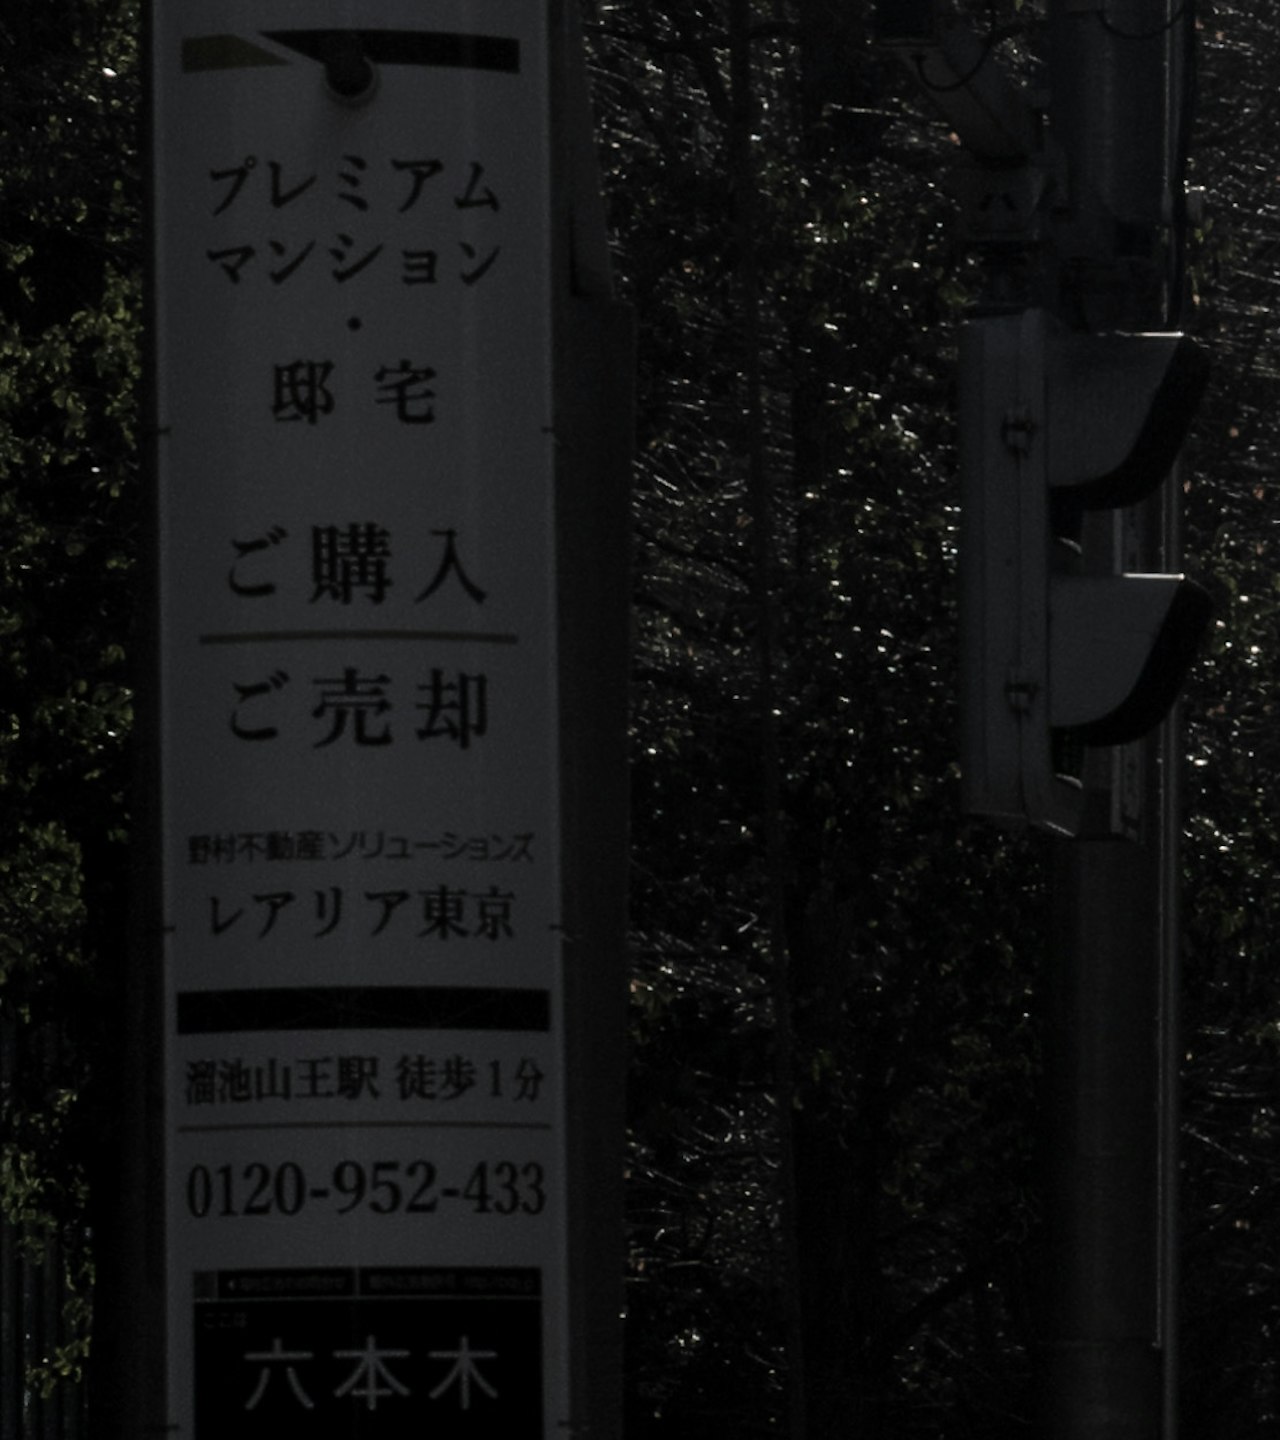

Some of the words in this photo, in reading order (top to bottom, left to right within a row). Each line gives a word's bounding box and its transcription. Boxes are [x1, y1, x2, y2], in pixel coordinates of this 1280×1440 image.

[209, 155, 501, 214] プレミアム
[207, 232, 502, 287] マンション
[271, 359, 438, 426] 邸宅
[226, 522, 488, 606] ご購入
[228, 665, 488, 750] ご売却
[188, 831, 534, 864] 野村不動産ソリューションズ
[210, 884, 515, 940] レアリア東京
[186, 1057, 380, 1104] 溜池山王駅
[395, 1056, 544, 1103] 徒歩1分
[187, 1161, 546, 1217] 0120-952-433
[243, 1334, 500, 1412] 六本木
